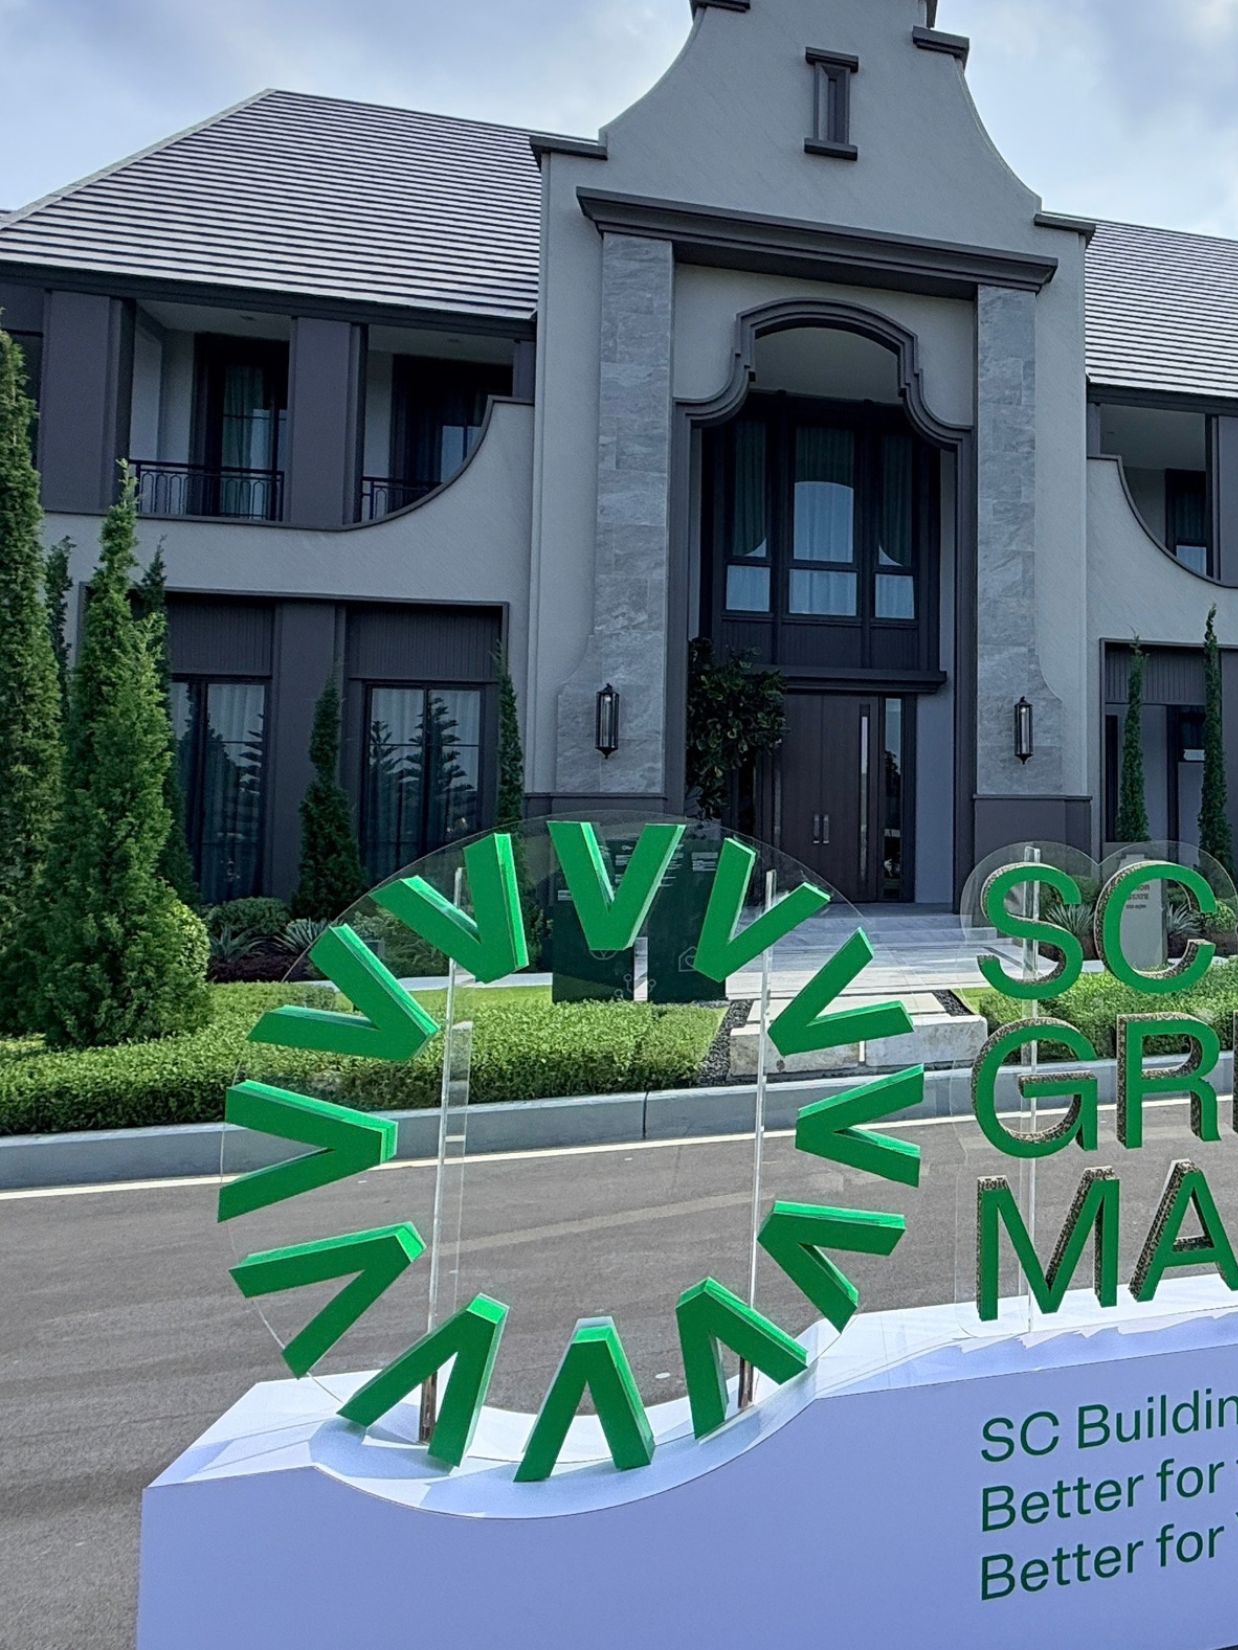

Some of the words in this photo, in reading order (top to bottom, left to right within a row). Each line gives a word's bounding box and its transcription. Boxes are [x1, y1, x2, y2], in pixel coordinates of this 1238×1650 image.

[977, 860, 1217, 999] SC
[981, 1411, 1060, 1463] SC
[982, 1474, 1144, 1533] Better
[1156, 1458, 1225, 1502] for
[981, 1540, 1144, 1601] Better
[1155, 1523, 1225, 1568] for
